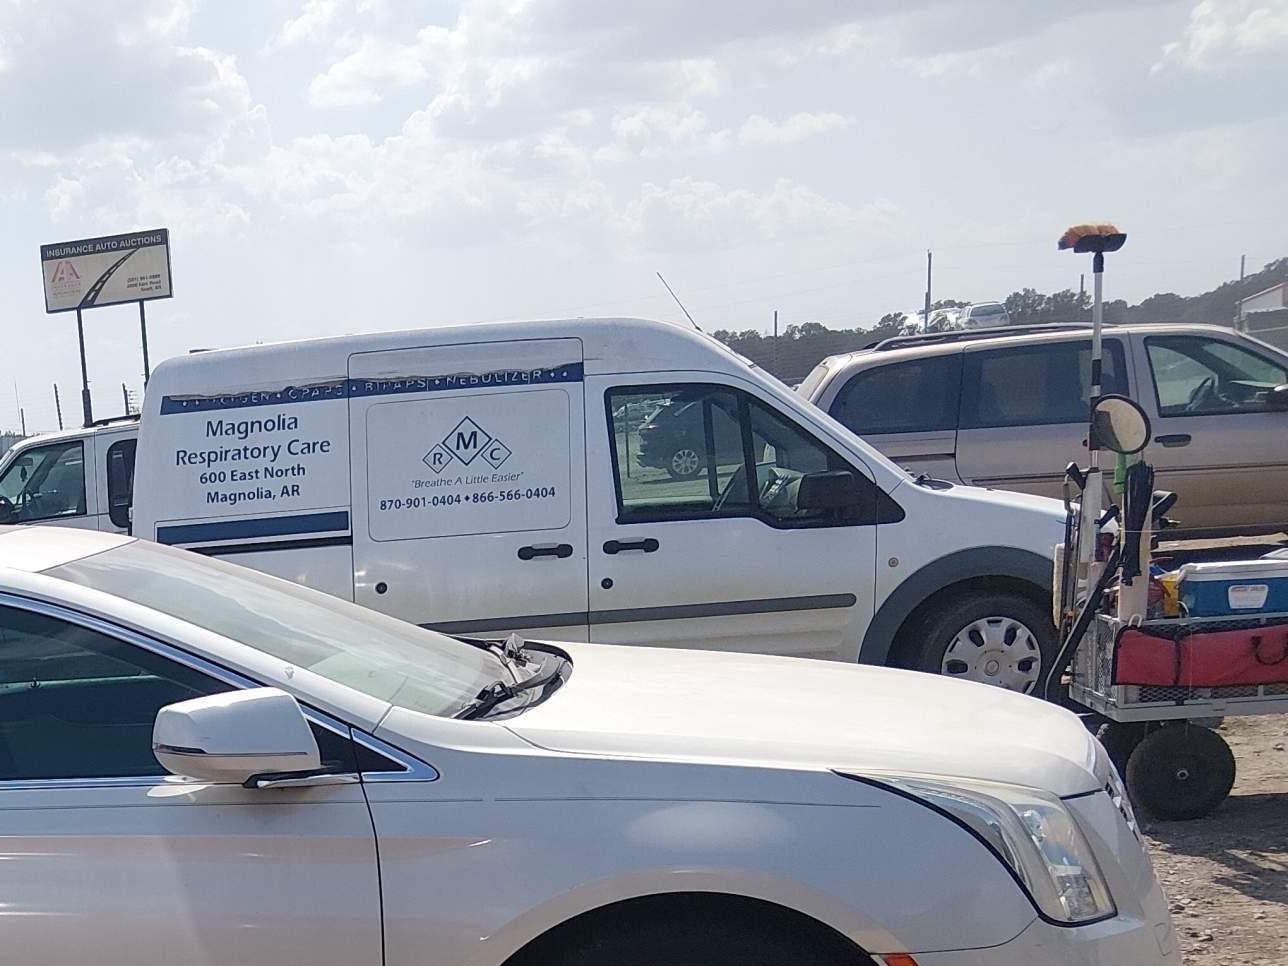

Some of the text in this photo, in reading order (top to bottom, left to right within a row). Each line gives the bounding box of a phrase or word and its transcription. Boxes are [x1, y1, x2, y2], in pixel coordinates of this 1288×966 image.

[46, 234, 162, 257] INSURANCE AUTO AUCTIONS
[446, 370, 542, 385] NEBULIZER
[205, 413, 299, 440] Magnolia
[176, 439, 331, 468] Respiratory Care
[199, 464, 306, 485] 600 East North
[454, 475, 463, 486] A
[465, 473, 489, 485] Little
[206, 484, 301, 505] Magnolia, AR
[379, 486, 556, 511] 870-901-0404 866-566-0404
